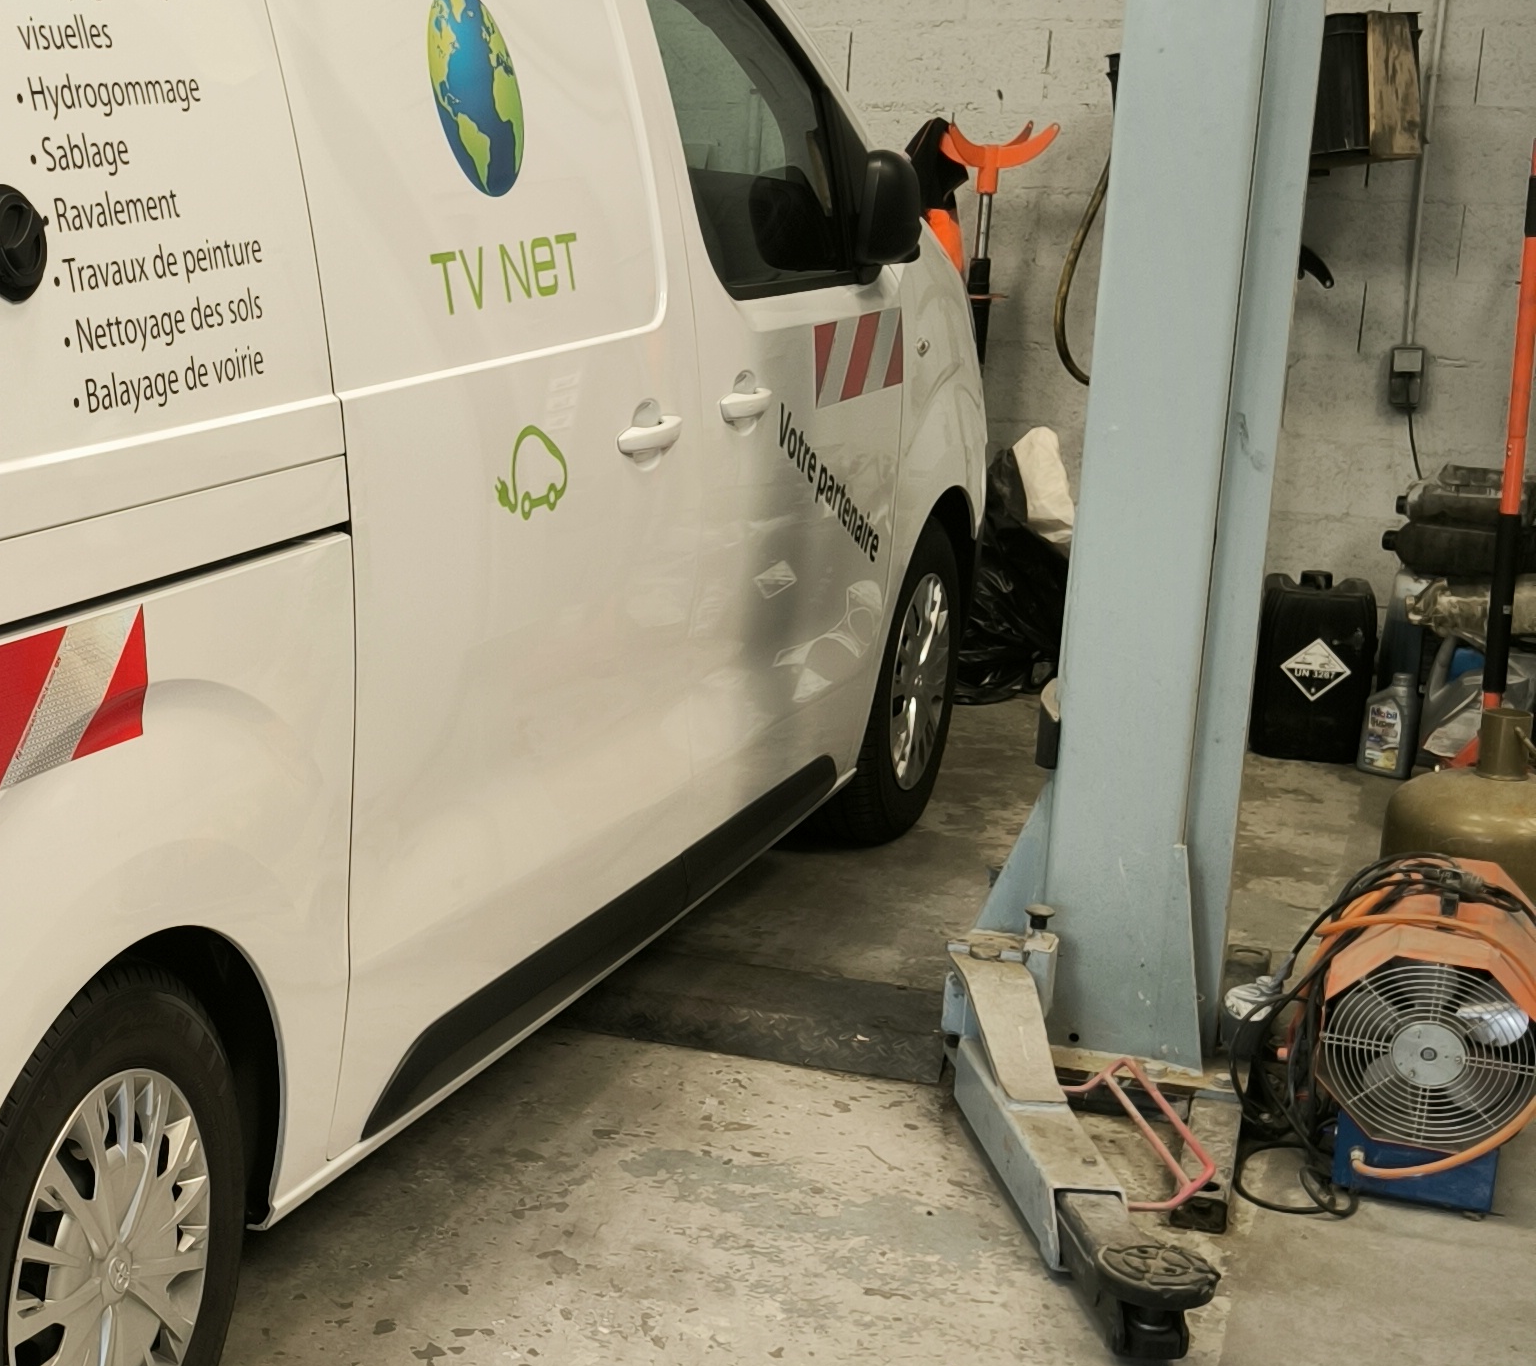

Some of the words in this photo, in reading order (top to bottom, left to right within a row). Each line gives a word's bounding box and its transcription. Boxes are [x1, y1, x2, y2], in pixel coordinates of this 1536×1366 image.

[17, 14, 112, 50] visuelles
[27, 74, 201, 120] Hydrogommage
[42, 133, 129, 176] Sablage
[54, 190, 180, 232] Ravalement
[62, 257, 149, 292] Travaux
[153, 244, 178, 279] de
[183, 240, 262, 283] peinture
[430, 246, 483, 316] TV
[76, 310, 185, 353] Nettoyage
[191, 296, 223, 331] des
[228, 287, 262, 324] sols
[85, 370, 179, 413] Balayage
[185, 356, 208, 390] de
[213, 348, 264, 383] voirie
[780, 403, 816, 484] Votre
[815, 464, 879, 562] partenaire
[1294, 668, 1310, 678] UN
